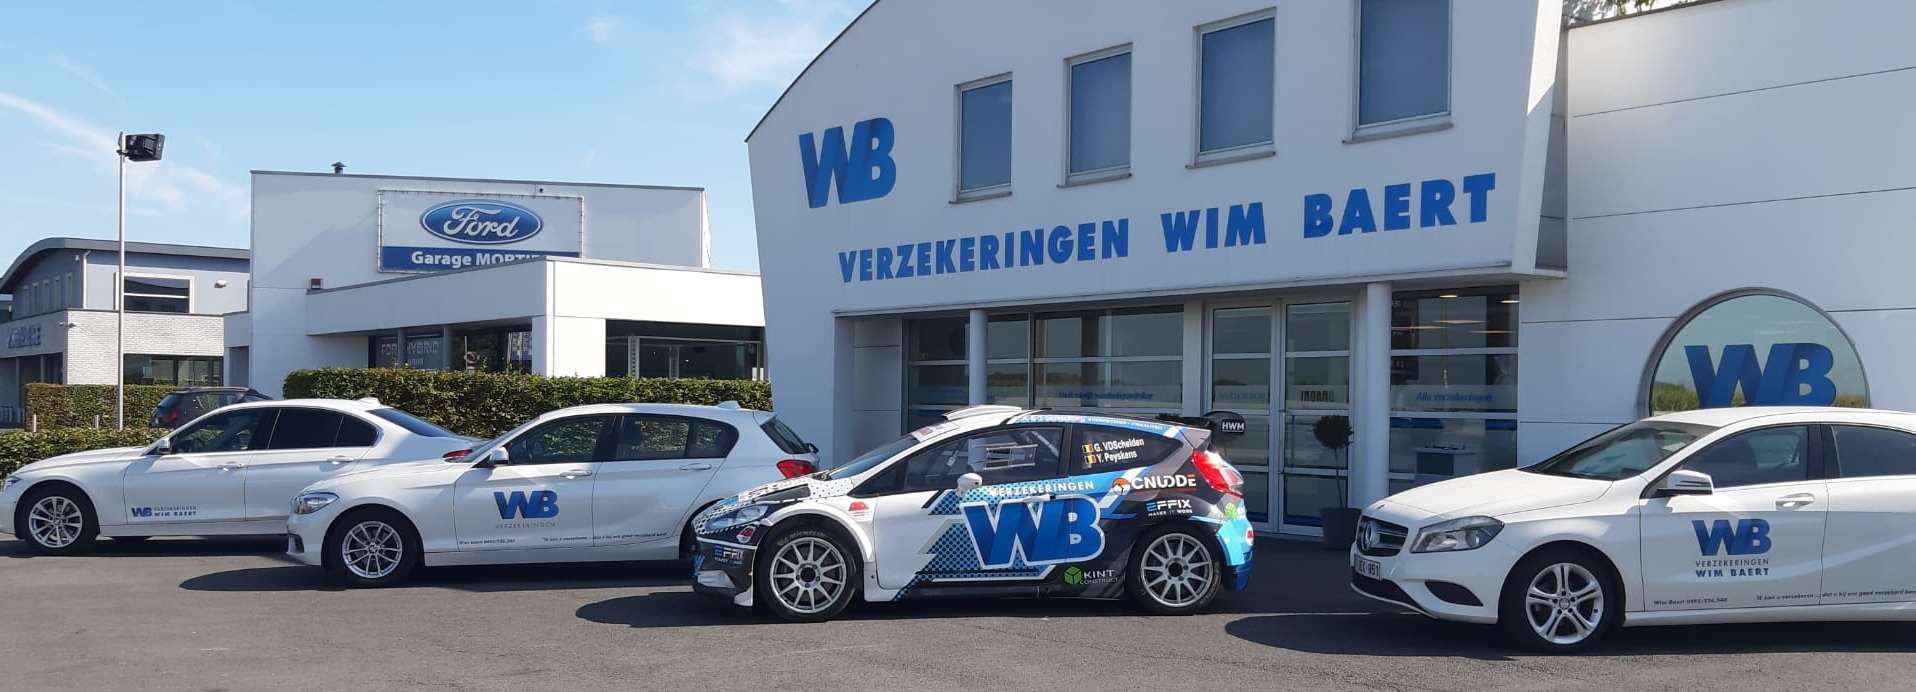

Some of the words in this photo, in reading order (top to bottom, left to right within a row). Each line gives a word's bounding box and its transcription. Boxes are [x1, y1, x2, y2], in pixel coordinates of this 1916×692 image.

[798, 117, 896, 208] WB
[443, 206, 520, 238] Ford
[838, 218, 1129, 283] VERZEKERINGEN
[1160, 202, 1266, 253] WIM
[1304, 172, 1496, 239] BAERT
[411, 250, 472, 268] Garage
[1683, 343, 1837, 408] WB
[1221, 421, 1245, 432] HWM
[1093, 443, 1104, 453] G.
[1095, 453, 1105, 463] Y.
[1104, 450, 1138, 463] Peyskens
[989, 480, 1095, 497] VERZEKERINGEN
[1131, 473, 1197, 490] CNUDDE
[131, 507, 153, 517] WB
[493, 490, 560, 520] WB
[1145, 499, 1192, 512] EFFIX
[959, 494, 1105, 569] WB
[1691, 518, 1772, 557] WB
[1695, 558, 1769, 568] VERZEKERINGEN
[1083, 569, 1115, 579] KINT
[1695, 569, 1724, 578] WIM
[1729, 567, 1769, 577] BAERT
